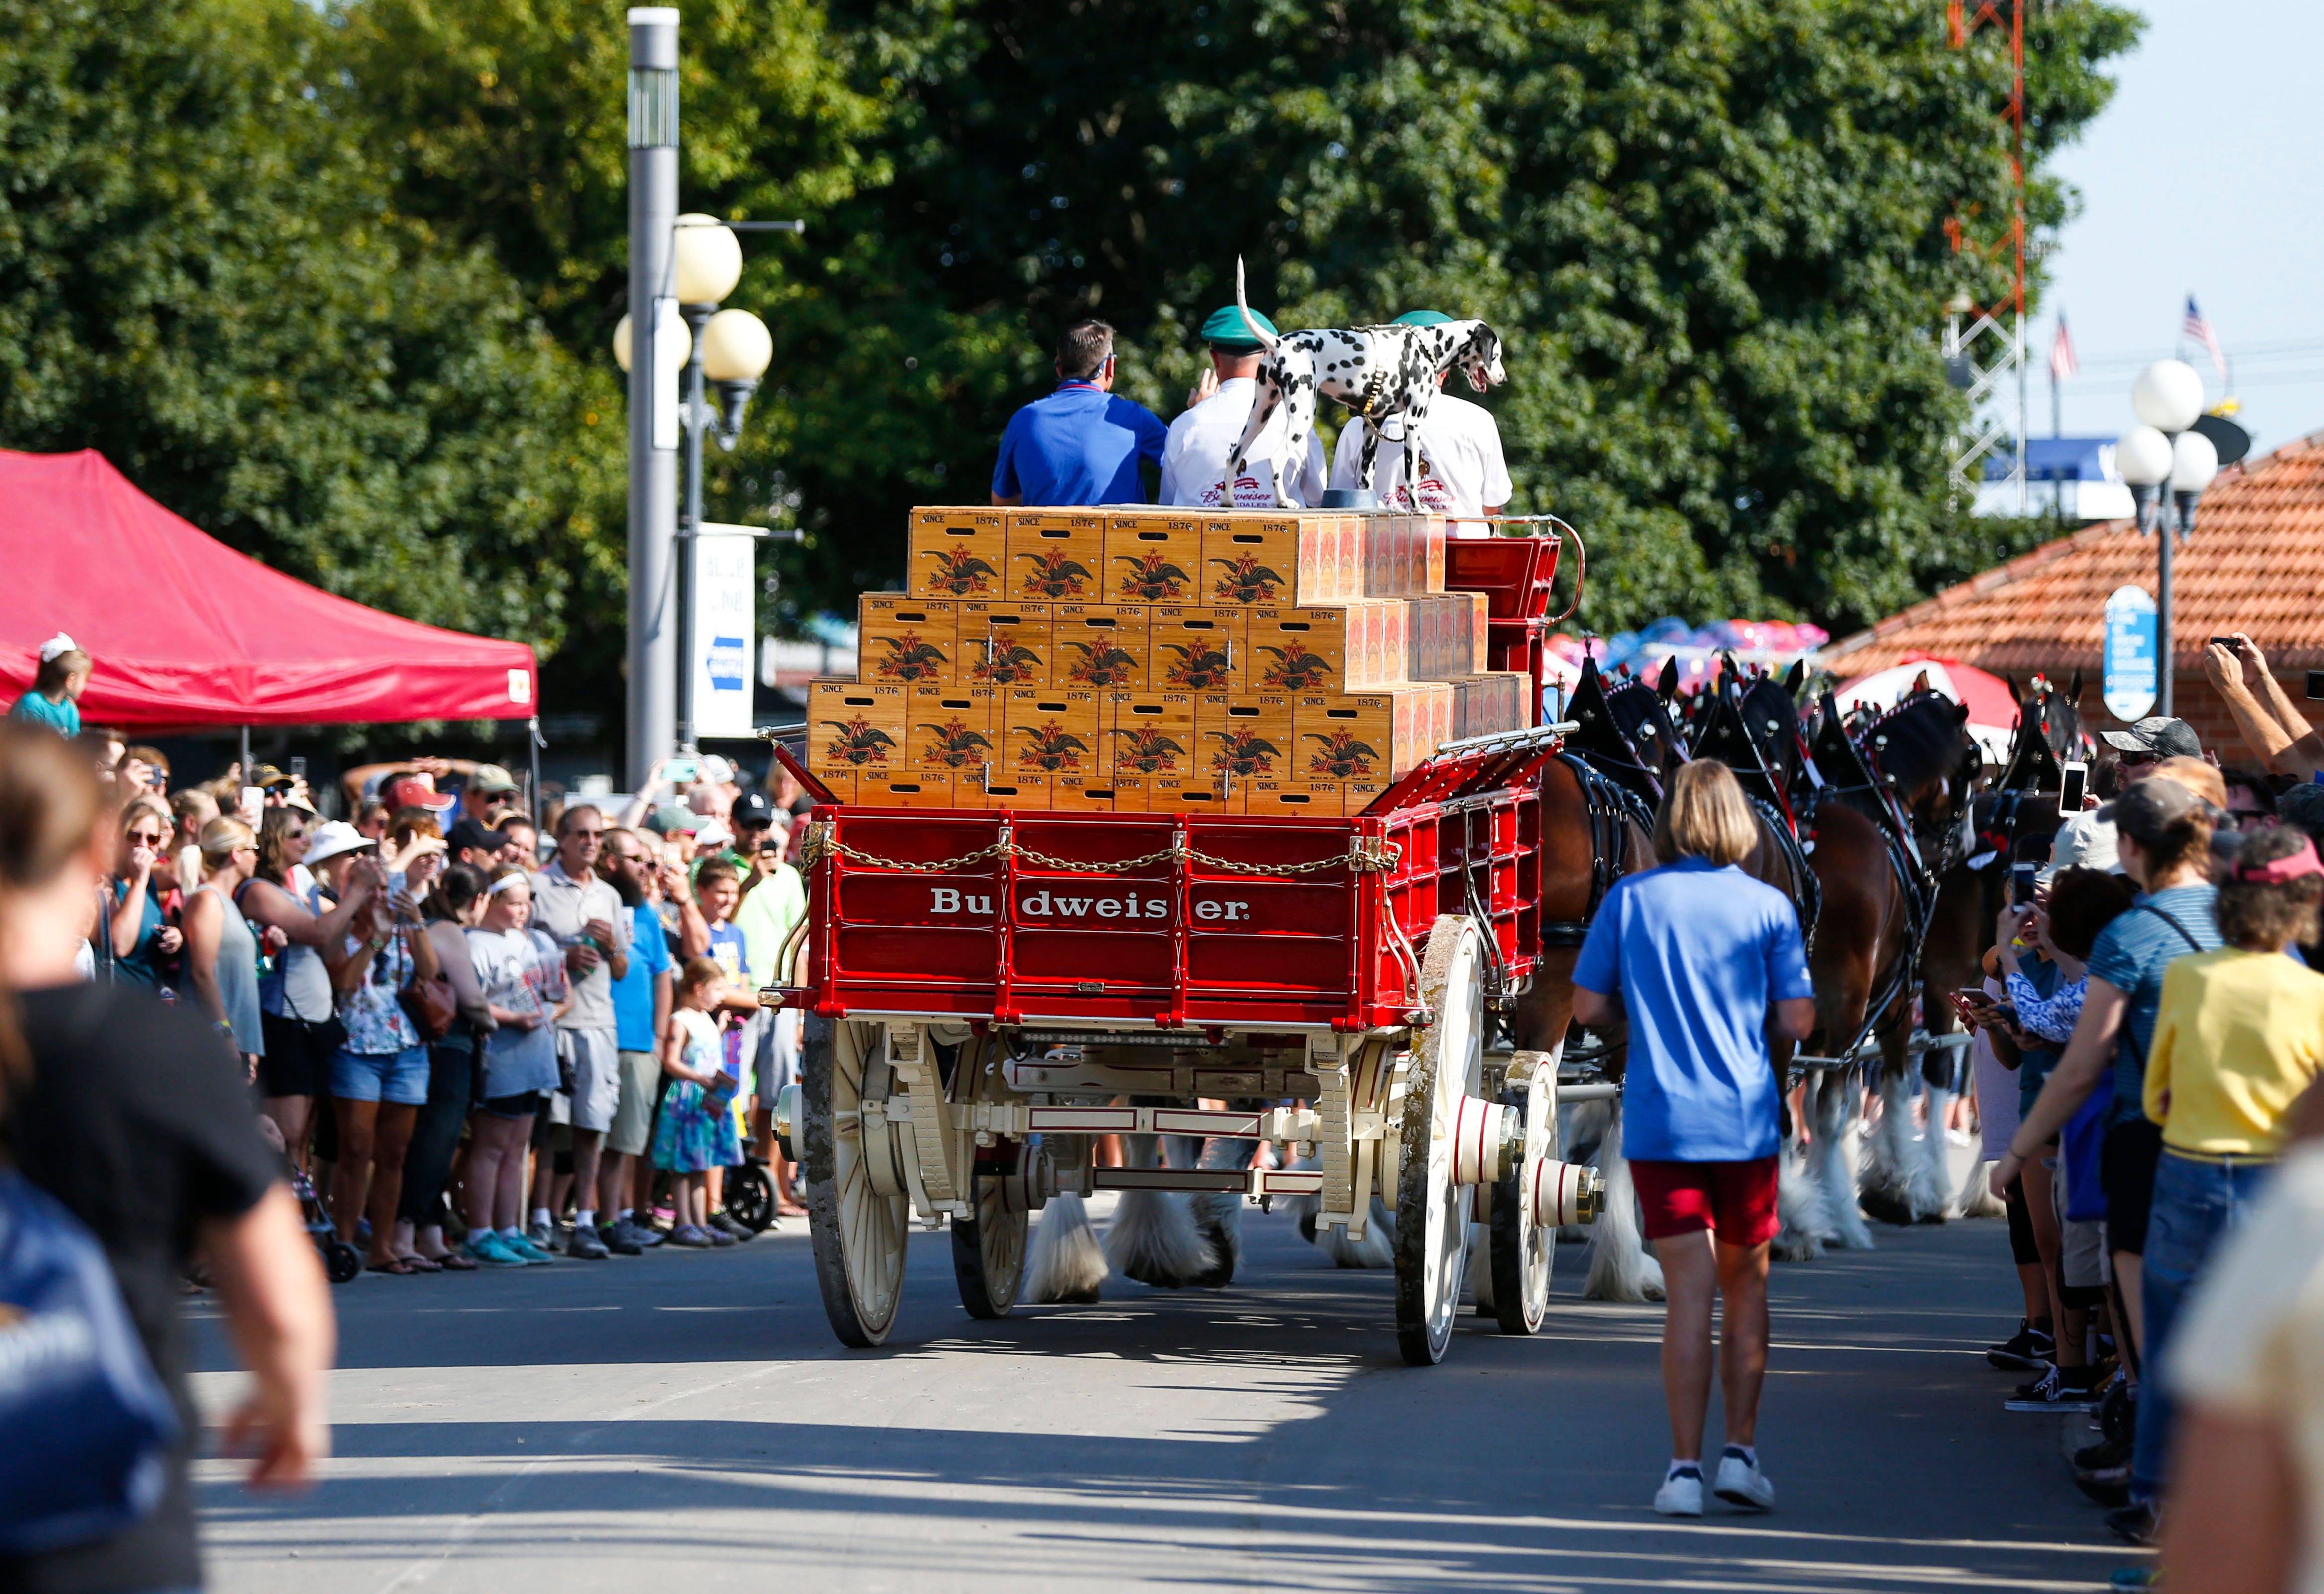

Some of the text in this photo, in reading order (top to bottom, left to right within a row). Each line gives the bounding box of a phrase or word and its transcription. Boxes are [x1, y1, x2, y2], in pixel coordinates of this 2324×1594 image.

[976, 517, 999, 526] 1876
[1071, 519, 1094, 528] 1876
[1169, 521, 1192, 531] 1876
[1209, 523, 1286, 533] SINCE 1876
[823, 770, 847, 778] 1876
[1159, 780, 1180, 789] SINCE
